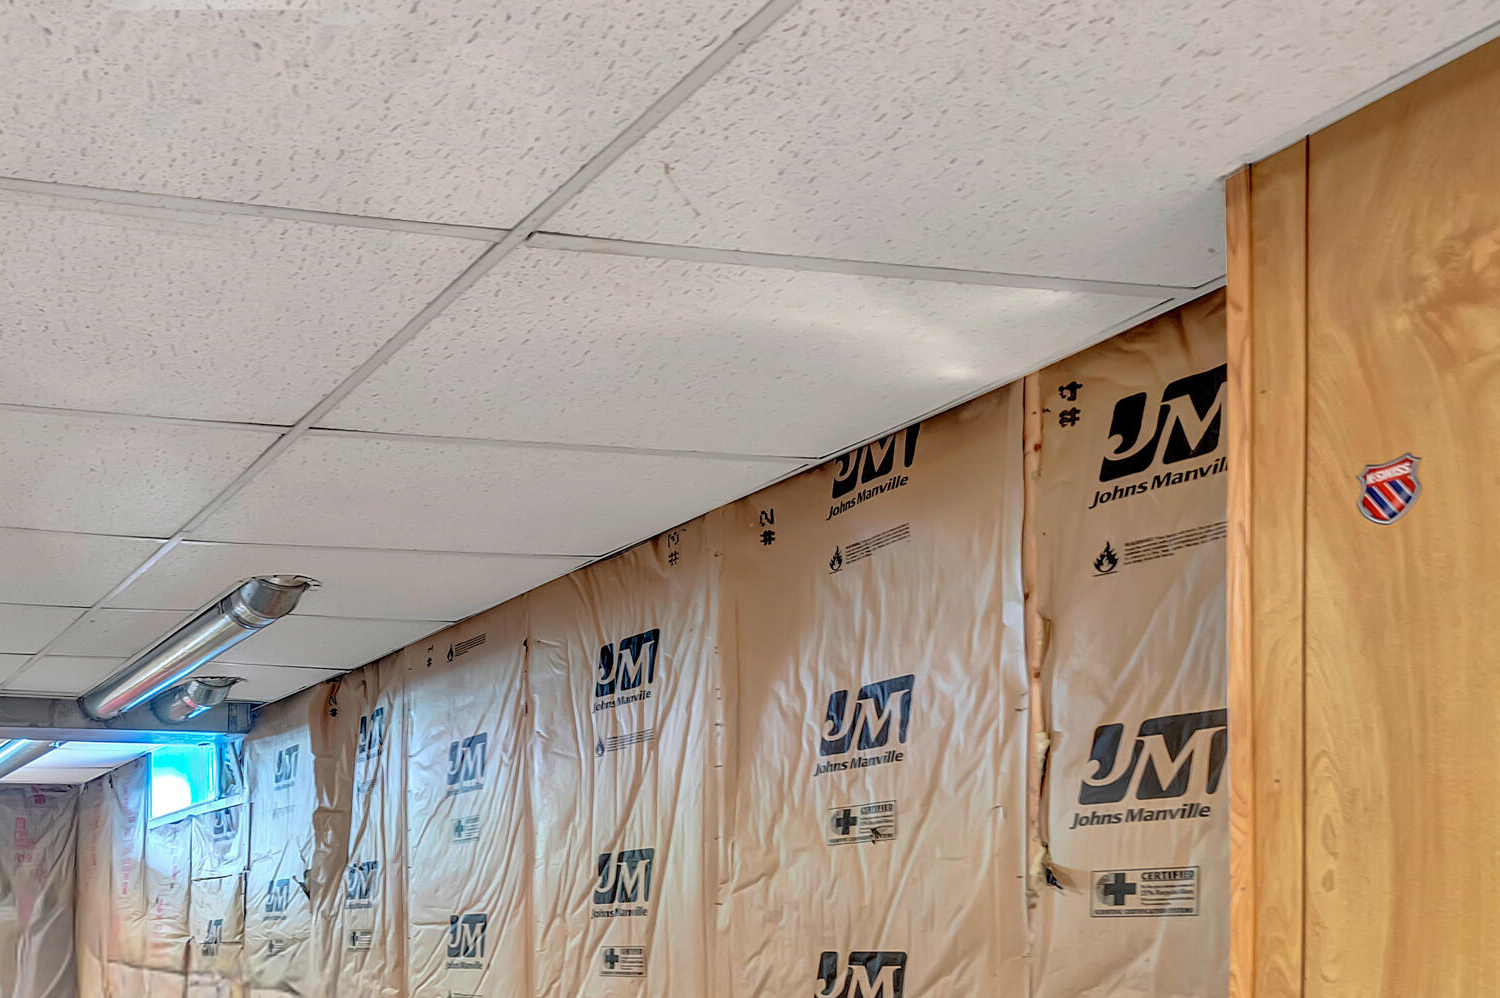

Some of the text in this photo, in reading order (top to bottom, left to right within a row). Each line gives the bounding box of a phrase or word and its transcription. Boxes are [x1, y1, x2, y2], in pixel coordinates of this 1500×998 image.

[1100, 363, 1227, 482] JM
[832, 423, 921, 499] JM
[826, 475, 908, 521] Johns Manville
[1088, 482, 1148, 509] Johns
[760, 508, 775, 546] #2
[596, 628, 660, 697] JM
[820, 674, 915, 756] JM
[447, 732, 488, 785] JM
[813, 750, 904, 776] Johns Manville
[1078, 708, 1227, 805] JM
[1069, 803, 1211, 830] Johns Manville
[594, 848, 654, 904] JM
[1141, 870, 1194, 881] CERTIFIED
[448, 913, 488, 957] JM
